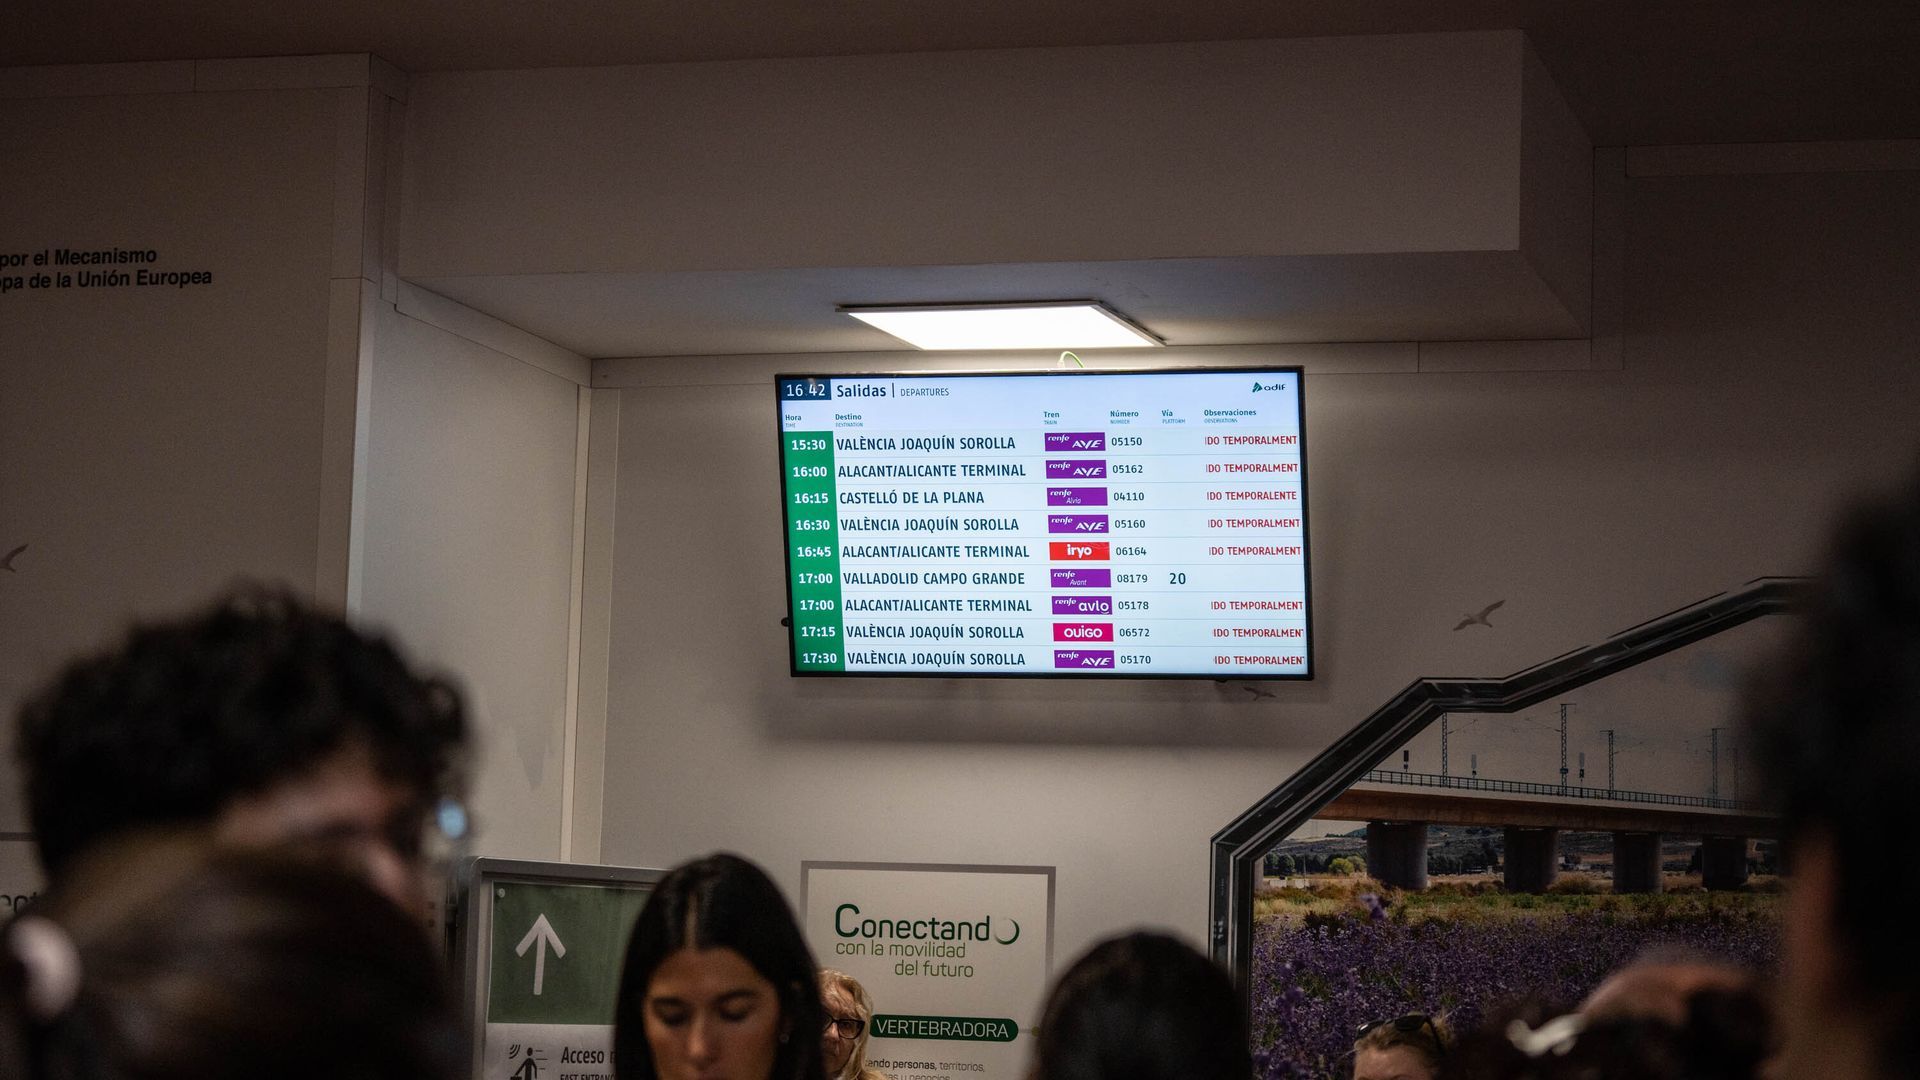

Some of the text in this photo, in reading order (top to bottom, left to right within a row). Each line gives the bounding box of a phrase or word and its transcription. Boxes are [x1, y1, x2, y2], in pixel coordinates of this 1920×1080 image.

[0, 247, 157, 271] por el Mecanismo
[29, 272, 52, 289] de
[57, 272, 71, 288] la
[78, 270, 130, 287] Unión
[137, 269, 212, 289] Europea
[836, 384, 950, 398] Salidas DEPARTURES
[1264, 383, 1286, 391] adif
[836, 434, 1016, 452] VALÈNCIA JOAQUÍN SOROLLA
[1048, 434, 1070, 444] renfe
[1072, 439, 1102, 450] AVE
[1111, 436, 1143, 447] 05150
[791, 439, 826, 451] 15:30
[838, 464, 1026, 478] ALACANT/ALICANTE TERMINAL
[1049, 461, 1071, 471] renfe
[1073, 467, 1103, 476] AVE
[1112, 464, 1143, 474] 05162
[793, 466, 827, 478] 16:00
[794, 493, 829, 504] 16:15
[840, 489, 984, 504] CASTELLÓ DE LA PLANA
[1050, 489, 1072, 498] renfe
[1113, 492, 1145, 502] 04110
[1225, 491, 1297, 500] TEMPORALENTE
[795, 519, 830, 530] 16:30
[840, 514, 1019, 532] VALÈNCIA JOAQUÍN SOROLLA
[1051, 516, 1073, 525] renfe
[1114, 519, 1146, 529] 05160
[1075, 522, 1106, 531] AVE
[797, 546, 832, 557] 16:45
[842, 545, 1030, 558] ALACANT/ALICANTE TERMINAL
[1067, 544, 1092, 559] iryo
[1115, 546, 1147, 556] 06164
[798, 573, 833, 584] 17:00
[843, 572, 1025, 585] VALLADOLID CAMPO GRANDE
[1053, 571, 1076, 579] renfe
[1116, 573, 1148, 583] 08179
[1169, 572, 1186, 585] 20
[800, 600, 834, 611] 17:00
[845, 599, 1032, 612] ALACANT/ALICANTE TERMINAL
[1055, 597, 1077, 606] renfe
[1078, 601, 1109, 612] avlo
[1118, 601, 1149, 610] 05178
[801, 626, 836, 637] 17:15
[846, 624, 1024, 641] VALÈNCIA JOAQUÍN SOROLLA
[1119, 628, 1150, 638] 06572
[802, 653, 837, 664] 17:30
[847, 651, 1026, 667] VALÈNCIA JOAQUÍN SOROLLA
[1057, 651, 1079, 660] renfe
[1120, 655, 1151, 665] 05170
[1081, 657, 1111, 666] AVE
[834, 903, 1020, 945] Conectando
[835, 940, 966, 958] con la movilidad
[894, 960, 974, 978] del futuro
[876, 1018, 1009, 1038] VERTEBRADORA
[561, 1046, 604, 1064] Acceso
[892, 1061, 937, 1070] personas,
